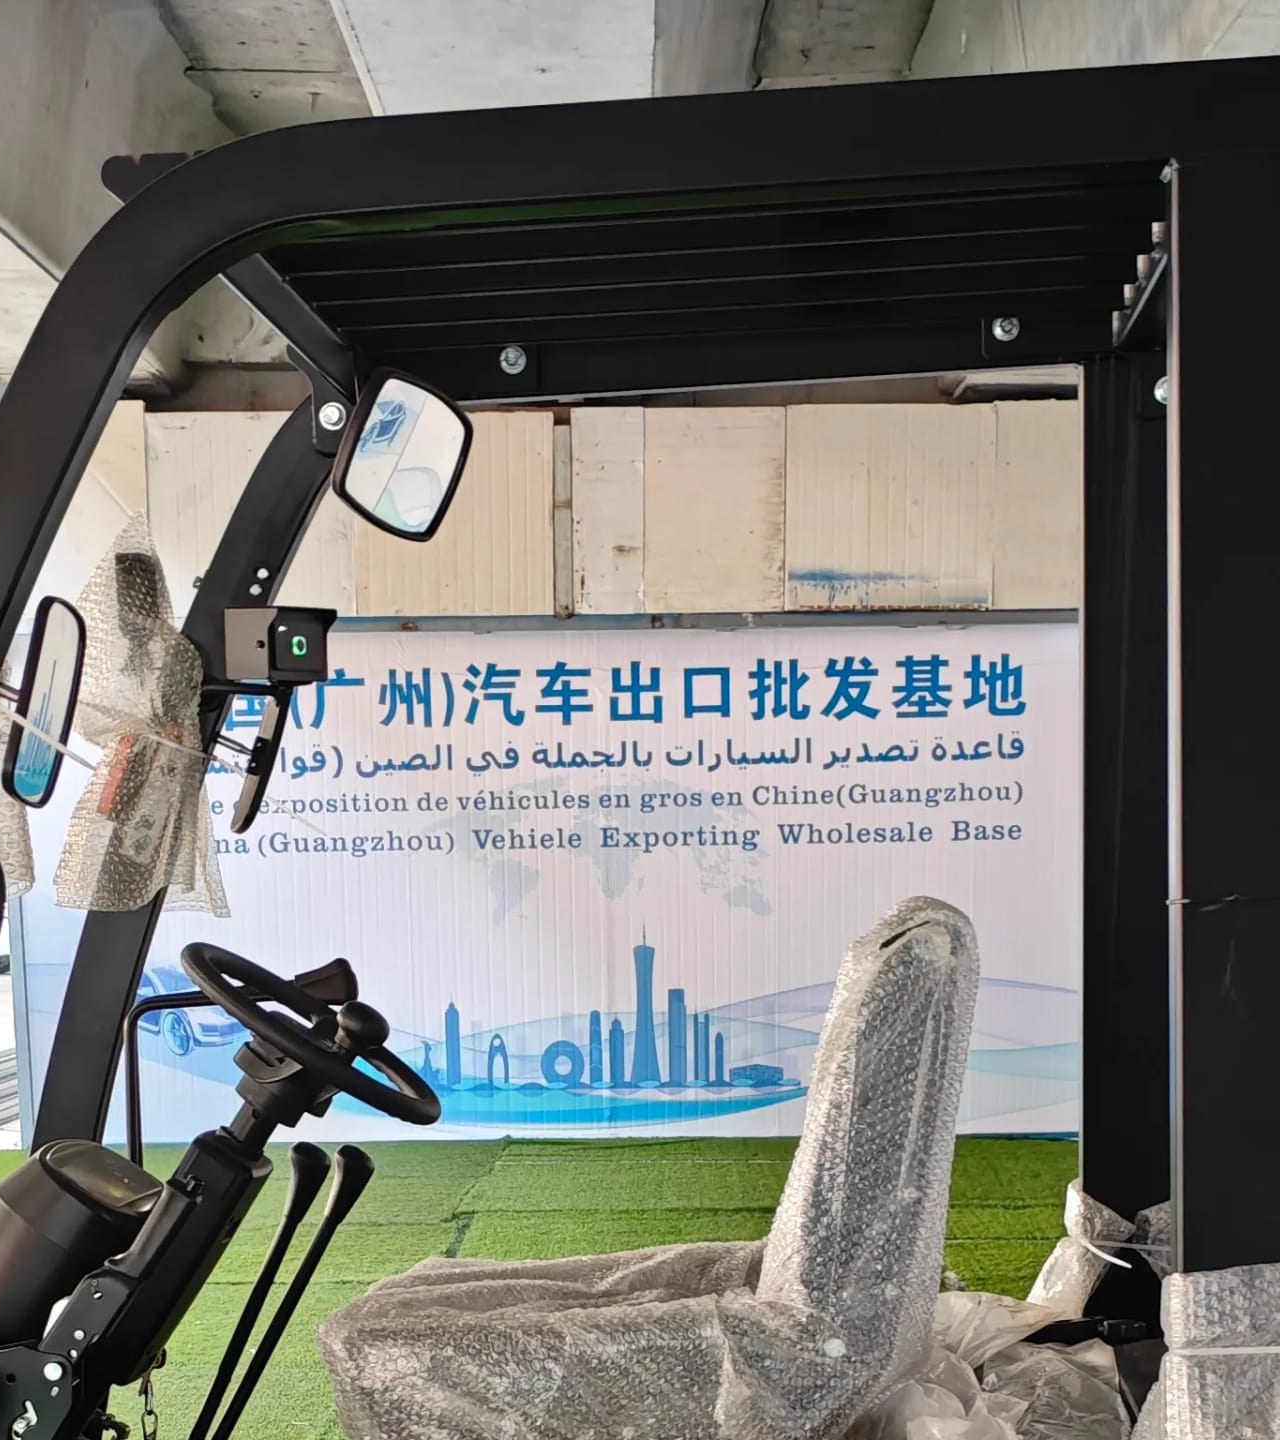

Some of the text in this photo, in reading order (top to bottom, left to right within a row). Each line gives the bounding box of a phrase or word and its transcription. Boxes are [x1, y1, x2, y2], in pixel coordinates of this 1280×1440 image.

[355, 743, 453, 778] الصين
[466, 741, 520, 778] في
[531, 741, 653, 774] بالجملة
[665, 738, 813, 772] السيارات
[823, 736, 919, 770] تصدير
[930, 730, 1025, 763] قاعدة
[234, 791, 408, 818] exposition
[417, 791, 448, 813] de
[459, 788, 590, 813] véhicules
[598, 793, 631, 810] en
[640, 790, 703, 813] gros
[711, 789, 743, 808] en
[752, 780, 1024, 809] Chine(Guangzhou)
[257, 829, 455, 858] (Guangzhou)
[471, 828, 583, 850] Vehiele
[599, 823, 760, 854] Exporting
[777, 821, 934, 845] Wholesale
[951, 820, 1023, 843] Base
